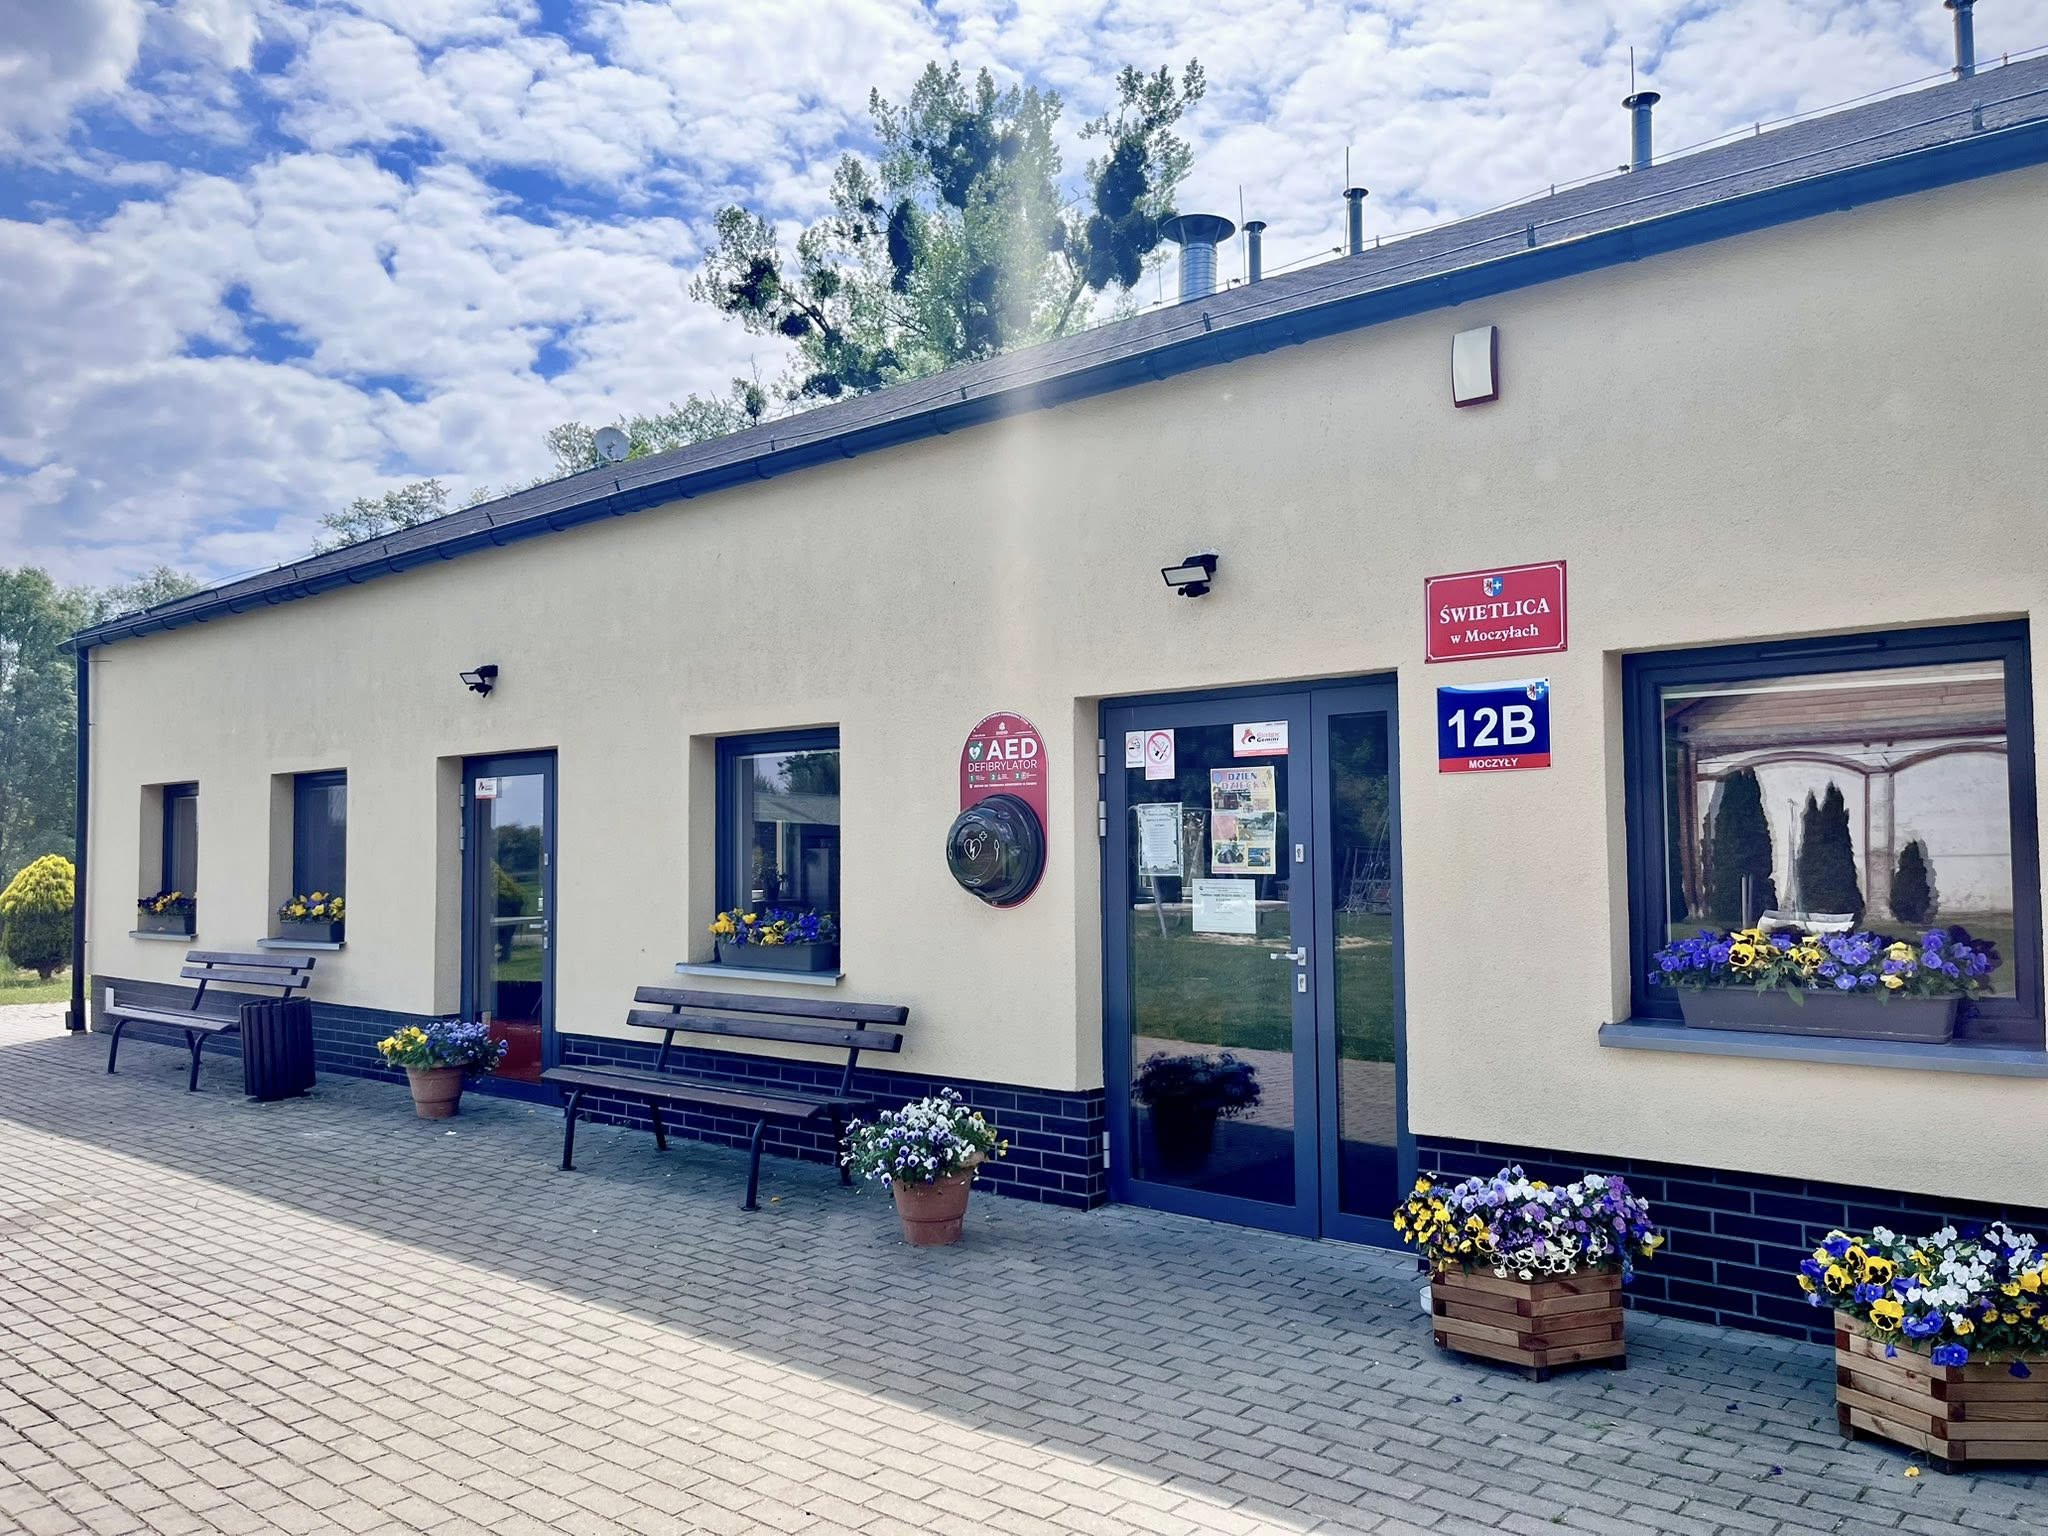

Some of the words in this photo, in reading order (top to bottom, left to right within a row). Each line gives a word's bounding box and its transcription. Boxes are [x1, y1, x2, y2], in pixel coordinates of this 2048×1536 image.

[1439, 597, 1550, 625] ŚWIETLICA
[1450, 634, 1461, 644] w
[1465, 623, 1539, 643] Moczyłach
[1448, 704, 1536, 748] 12B
[986, 737, 1038, 761] AED
[968, 759, 1038, 773] DEFIBRYLATOR
[1469, 757, 1519, 769] MOCZYŁY
[1221, 780, 1268, 790] DZIECKA
